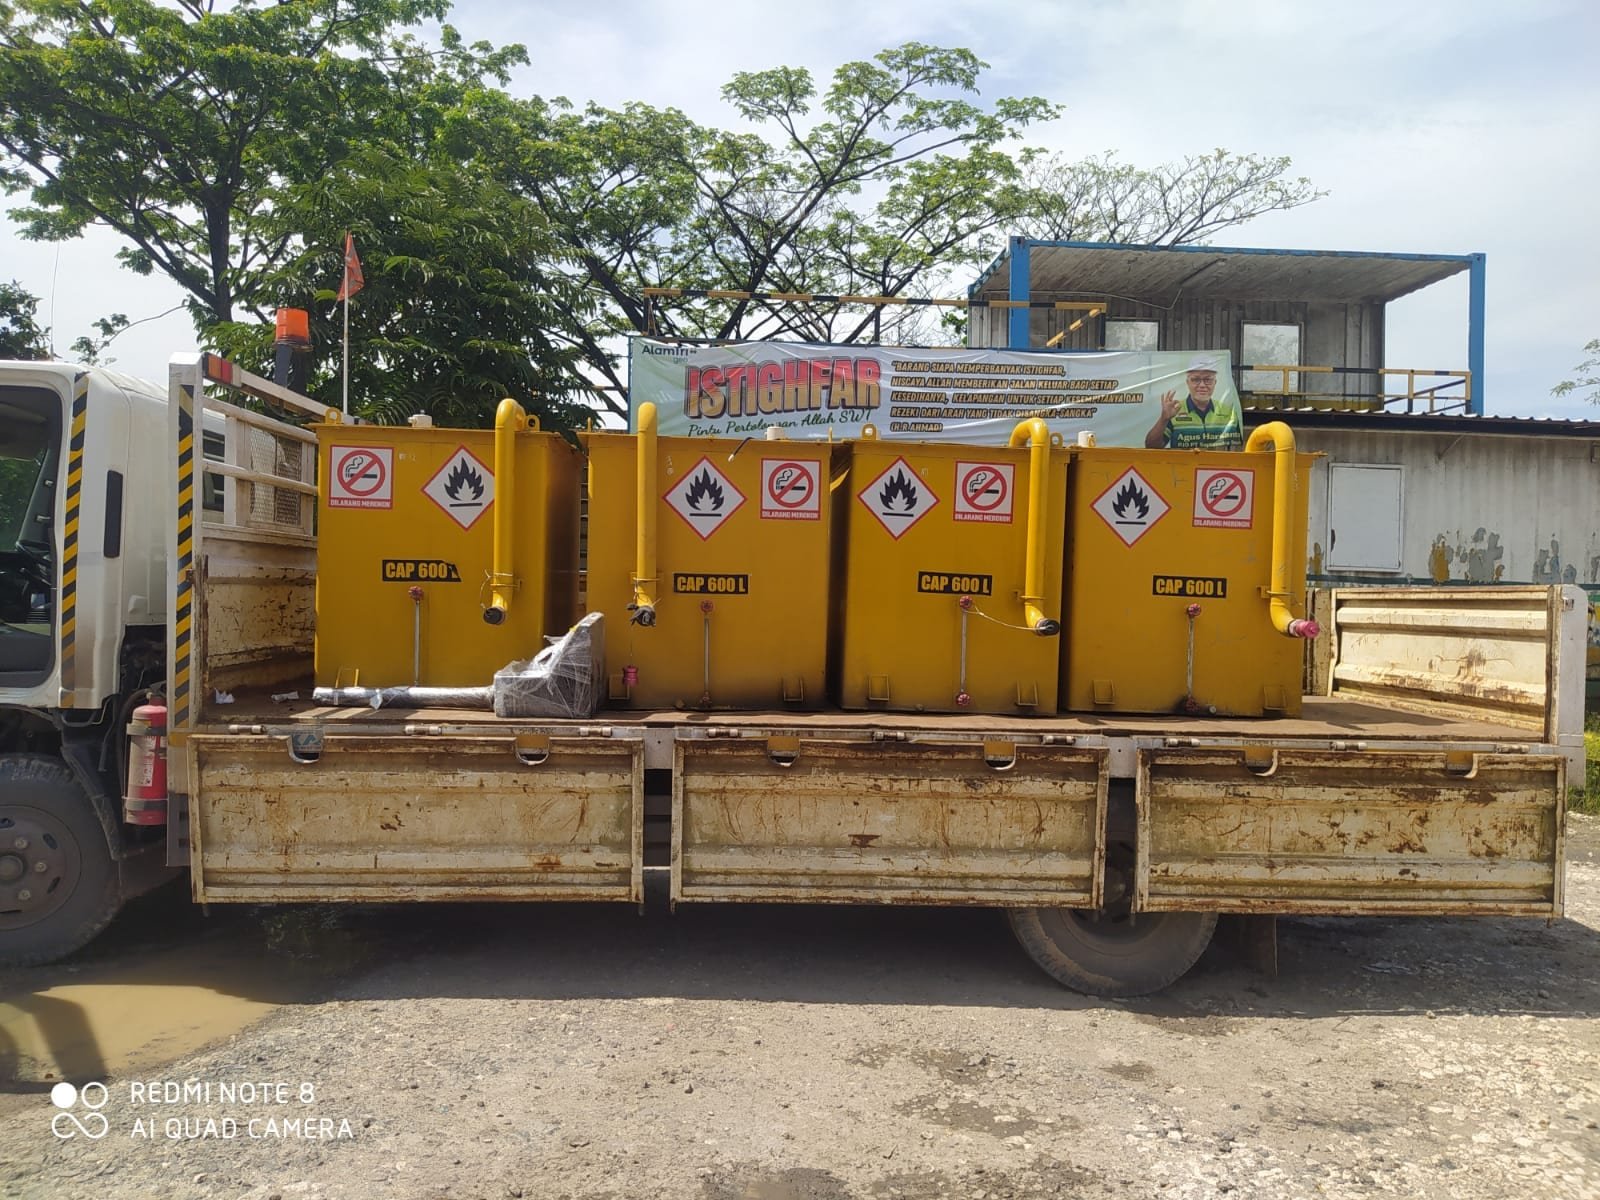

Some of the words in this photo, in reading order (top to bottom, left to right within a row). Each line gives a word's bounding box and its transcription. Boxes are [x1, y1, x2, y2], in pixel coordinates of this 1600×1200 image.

[931, 362, 955, 373] SIAPA
[956, 363, 1021, 375] MEMPERBANYAK
[686, 356, 881, 419] ISTIGHFAR
[891, 376, 926, 387] NISCAYA
[926, 377, 952, 388] ALLAH
[953, 378, 1009, 389] MEMBERIKAN
[1009, 379, 1036, 389] JALAN
[1037, 379, 1069, 390] KELUAR
[1069, 380, 1089, 390] BAGI
[1089, 380, 1119, 390] SETIAP
[952, 392, 1006, 404] KELAPANGAN
[1006, 393, 1036, 404] UNTUK
[1036, 394, 1064, 405] SETIAP
[1125, 393, 1143, 403] DAN
[890, 406, 920, 418] REZEKI
[920, 407, 941, 418] DARI
[941, 408, 965, 418] ARAH
[966, 408, 988, 418] YANG
[989, 408, 1014, 418] TIDAK
[688, 424, 721, 437] Pintu
[801, 412, 836, 426] Allah
[839, 408, 871, 423] SWT
[385, 562, 415, 578] CAP
[418, 562, 447, 579] 600
[677, 576, 704, 592] CAP
[708, 576, 735, 592] 600
[739, 577, 745, 592] L
[921, 575, 949, 591] CAP
[952, 577, 980, 593] 600
[983, 578, 989, 593] L
[1156, 578, 1183, 594] CAP
[1186, 579, 1213, 595] 600
[1217, 581, 1223, 595] L
